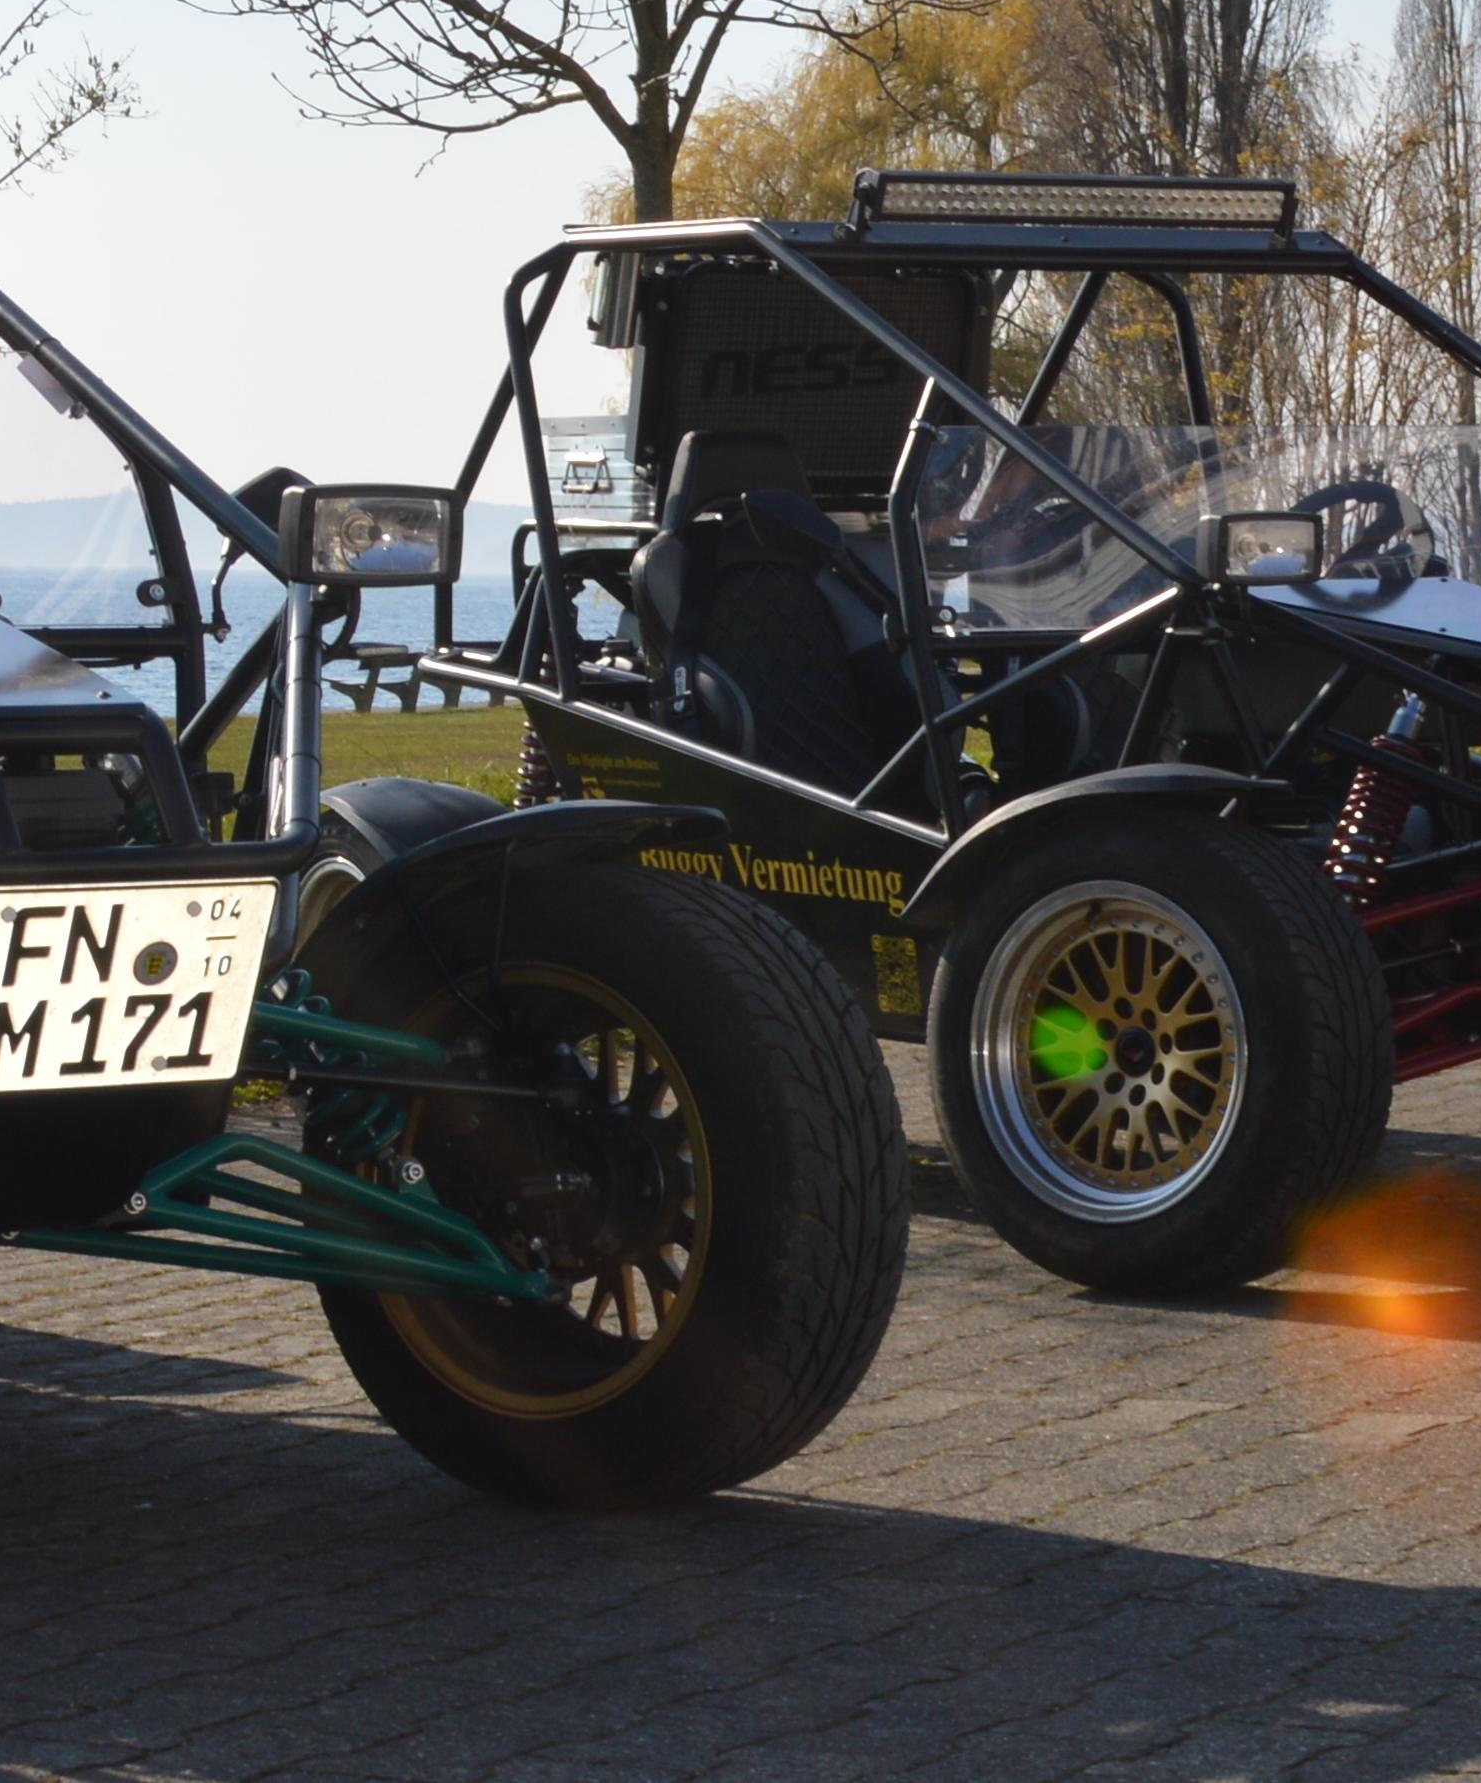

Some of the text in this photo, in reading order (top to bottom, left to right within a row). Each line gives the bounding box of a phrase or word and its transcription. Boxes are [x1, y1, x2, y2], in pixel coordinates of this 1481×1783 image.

[209, 899, 243, 921] 04
[728, 843, 907, 918] Vermietung
[1, 904, 125, 988] FN
[202, 955, 233, 978] 10
[58, 992, 214, 1076] 171
